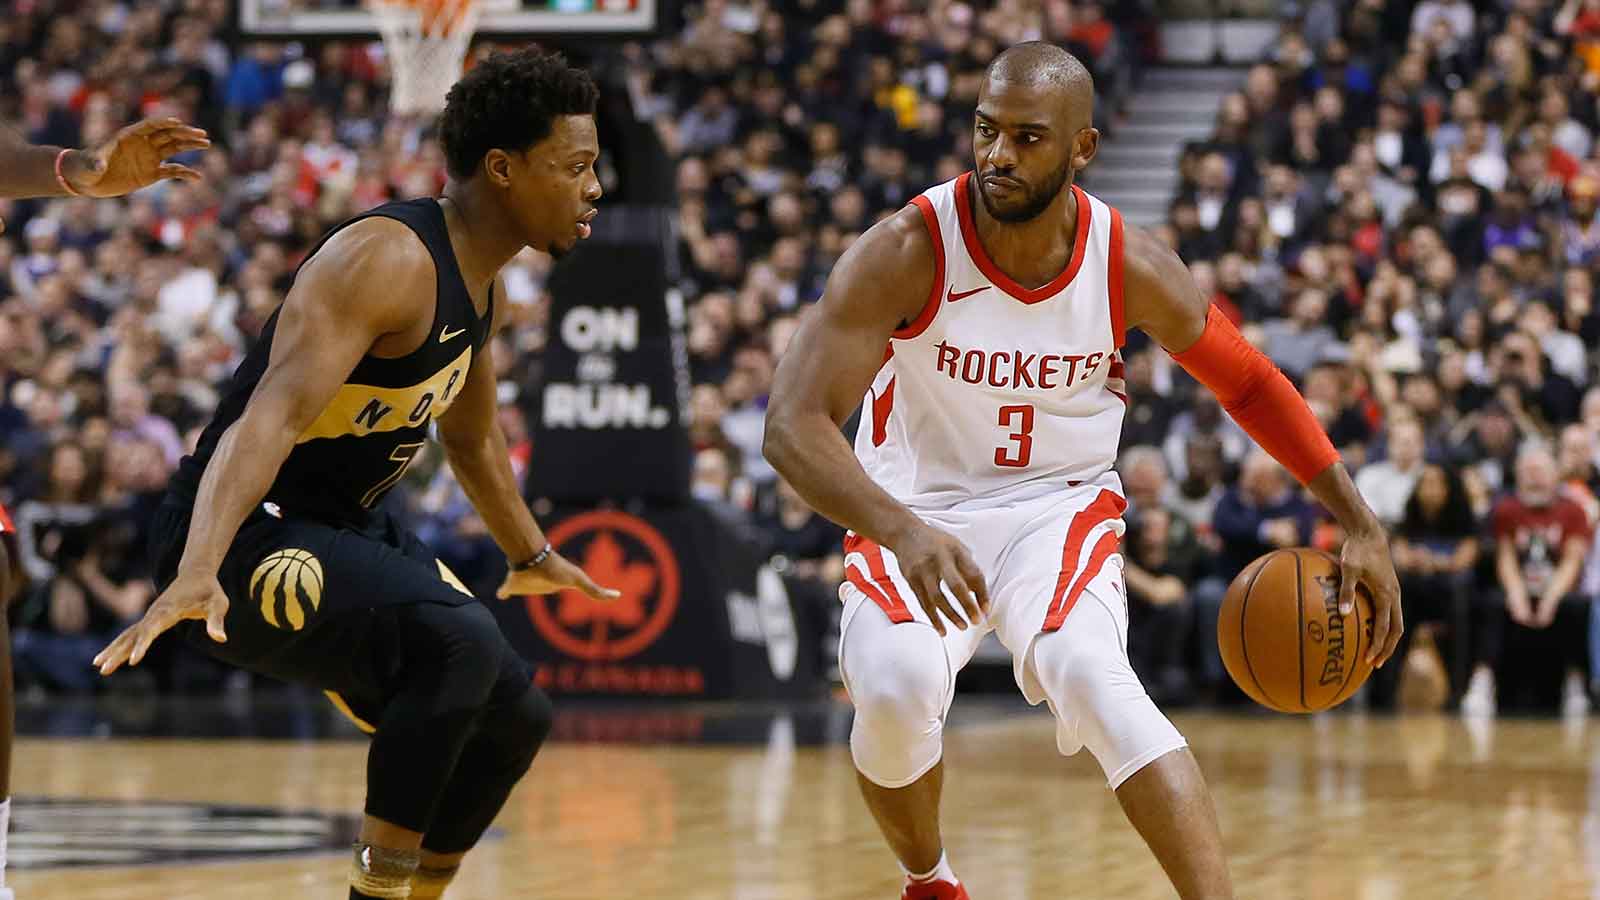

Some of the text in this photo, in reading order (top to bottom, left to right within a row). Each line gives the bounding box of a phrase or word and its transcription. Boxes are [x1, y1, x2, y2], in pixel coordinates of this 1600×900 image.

[561, 304, 640, 351] ON
[934, 340, 1104, 389] ROCKETS
[543, 381, 671, 430] RUN.
[993, 404, 1035, 468] 3
[359, 441, 425, 508] 7
